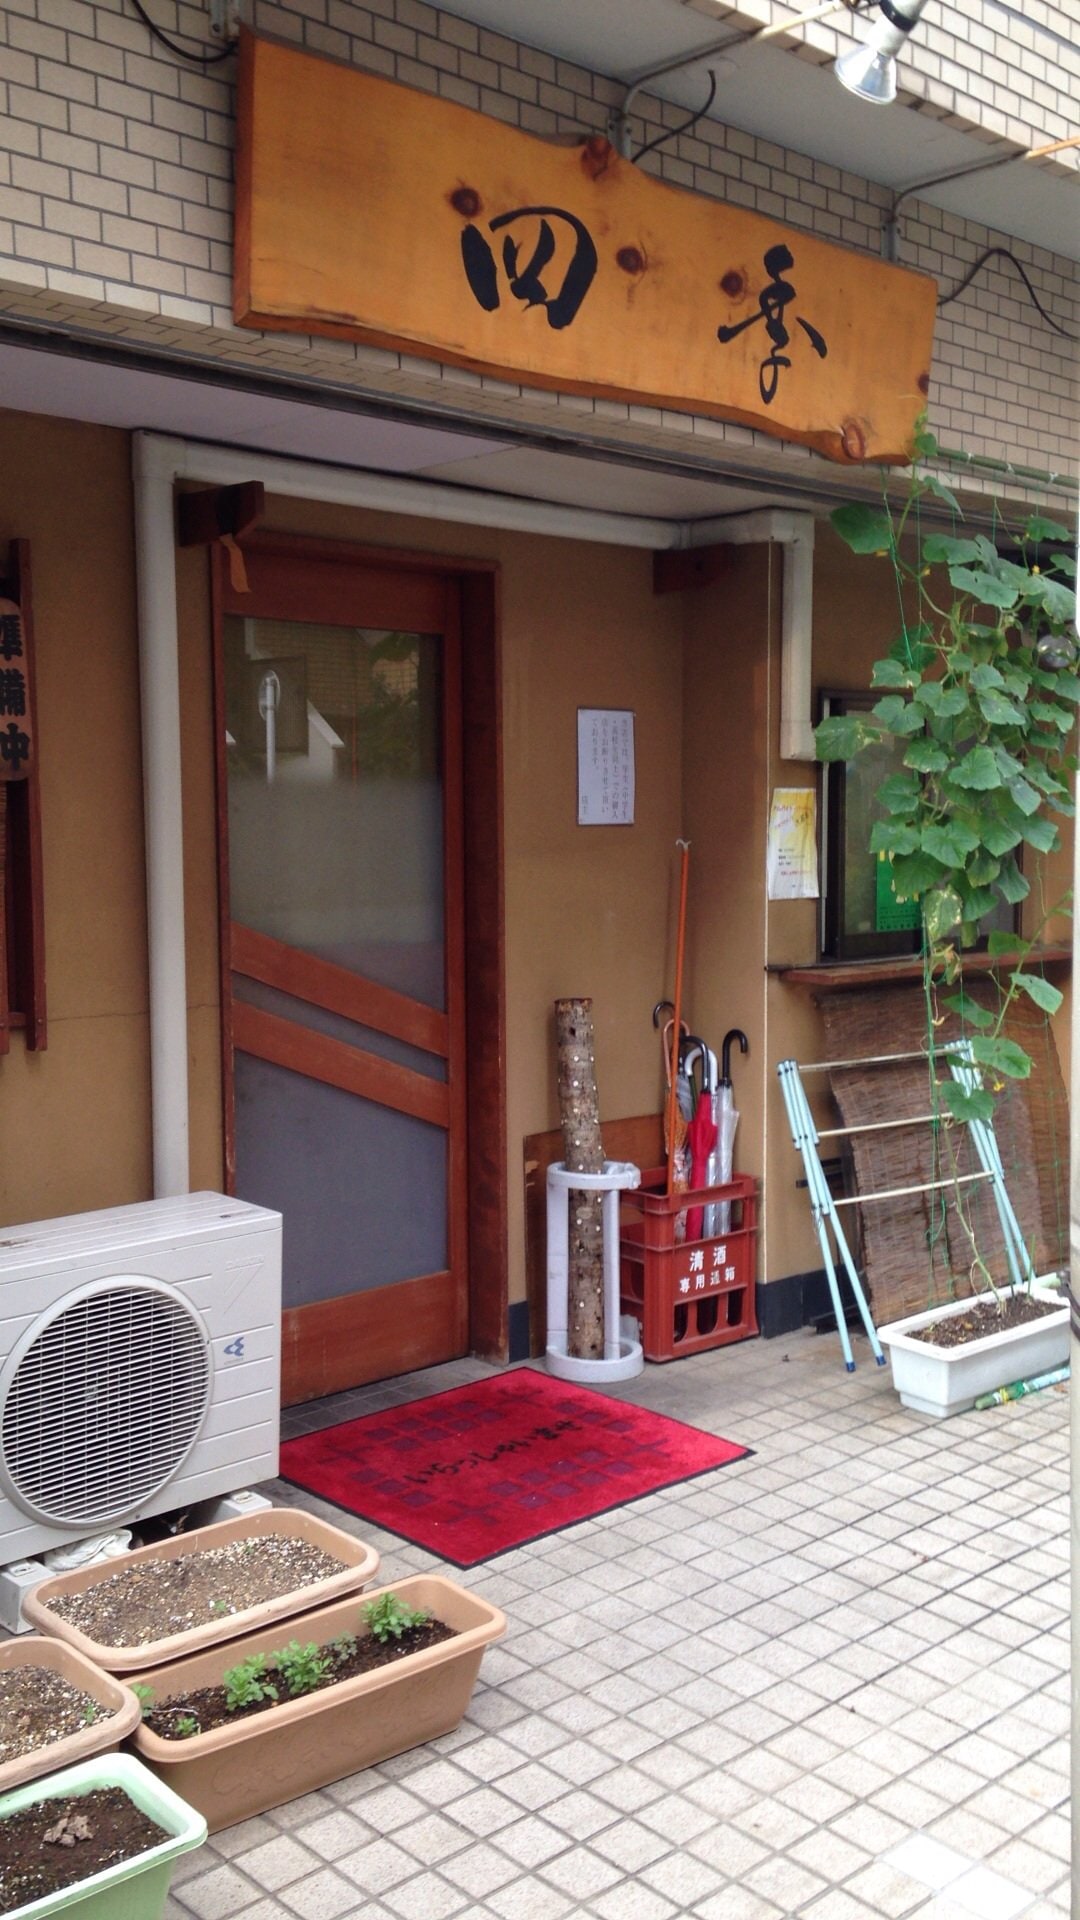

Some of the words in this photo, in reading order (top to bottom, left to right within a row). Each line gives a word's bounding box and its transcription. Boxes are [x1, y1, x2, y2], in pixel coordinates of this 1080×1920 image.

[461, 205, 827, 403] 四季
[689, 1244, 727, 1272] 清酒
[404, 1420, 582, 1484] いらっしゃいませ
